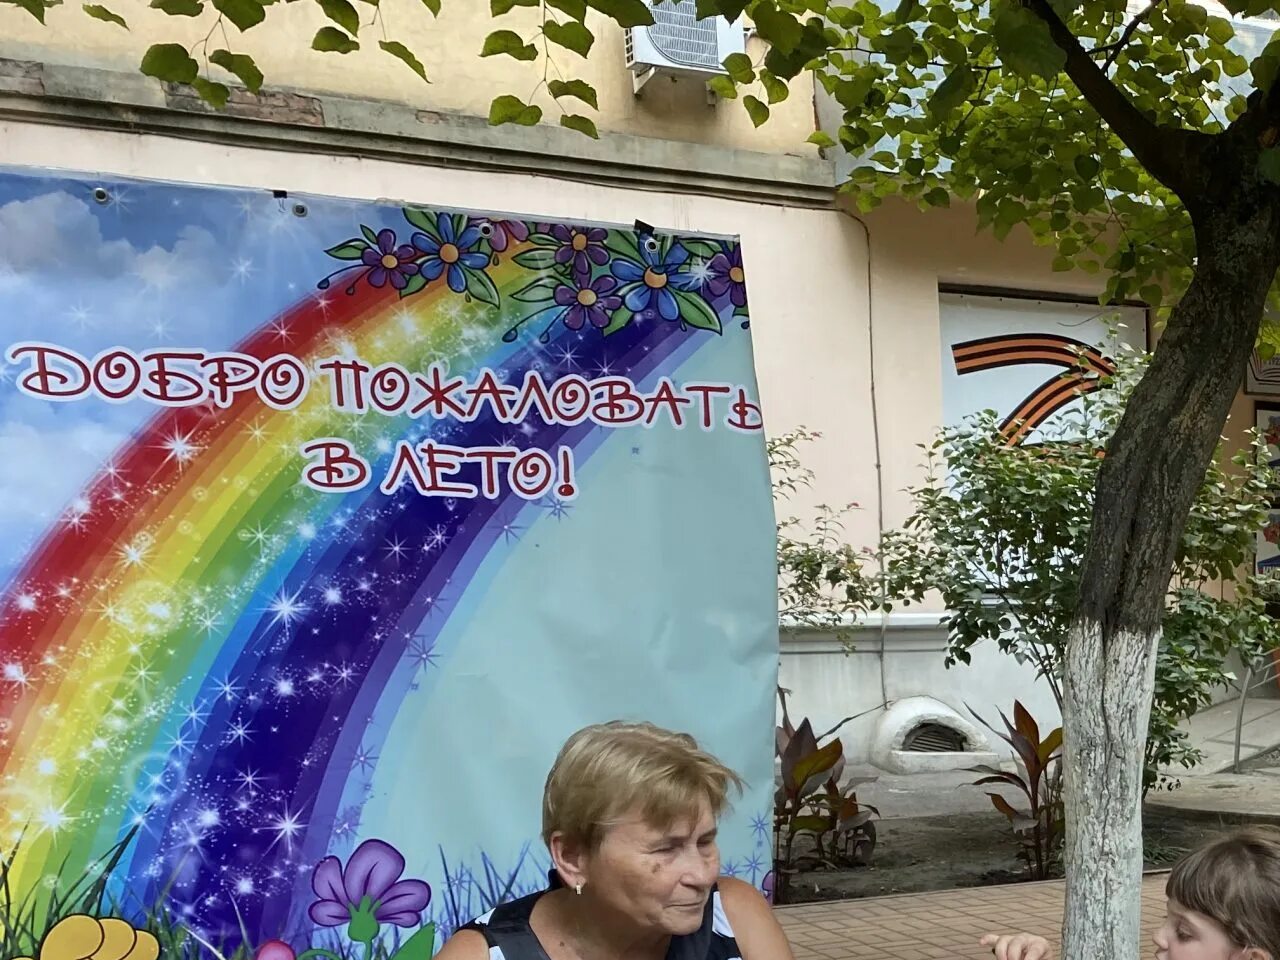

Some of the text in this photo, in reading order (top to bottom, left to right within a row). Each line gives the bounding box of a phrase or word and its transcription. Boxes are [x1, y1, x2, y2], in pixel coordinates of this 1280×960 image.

[11, 346, 764, 431] ДОБРО ПОЖАЛОВАТЬ
[304, 442, 575, 497] В ЛЕТО!
